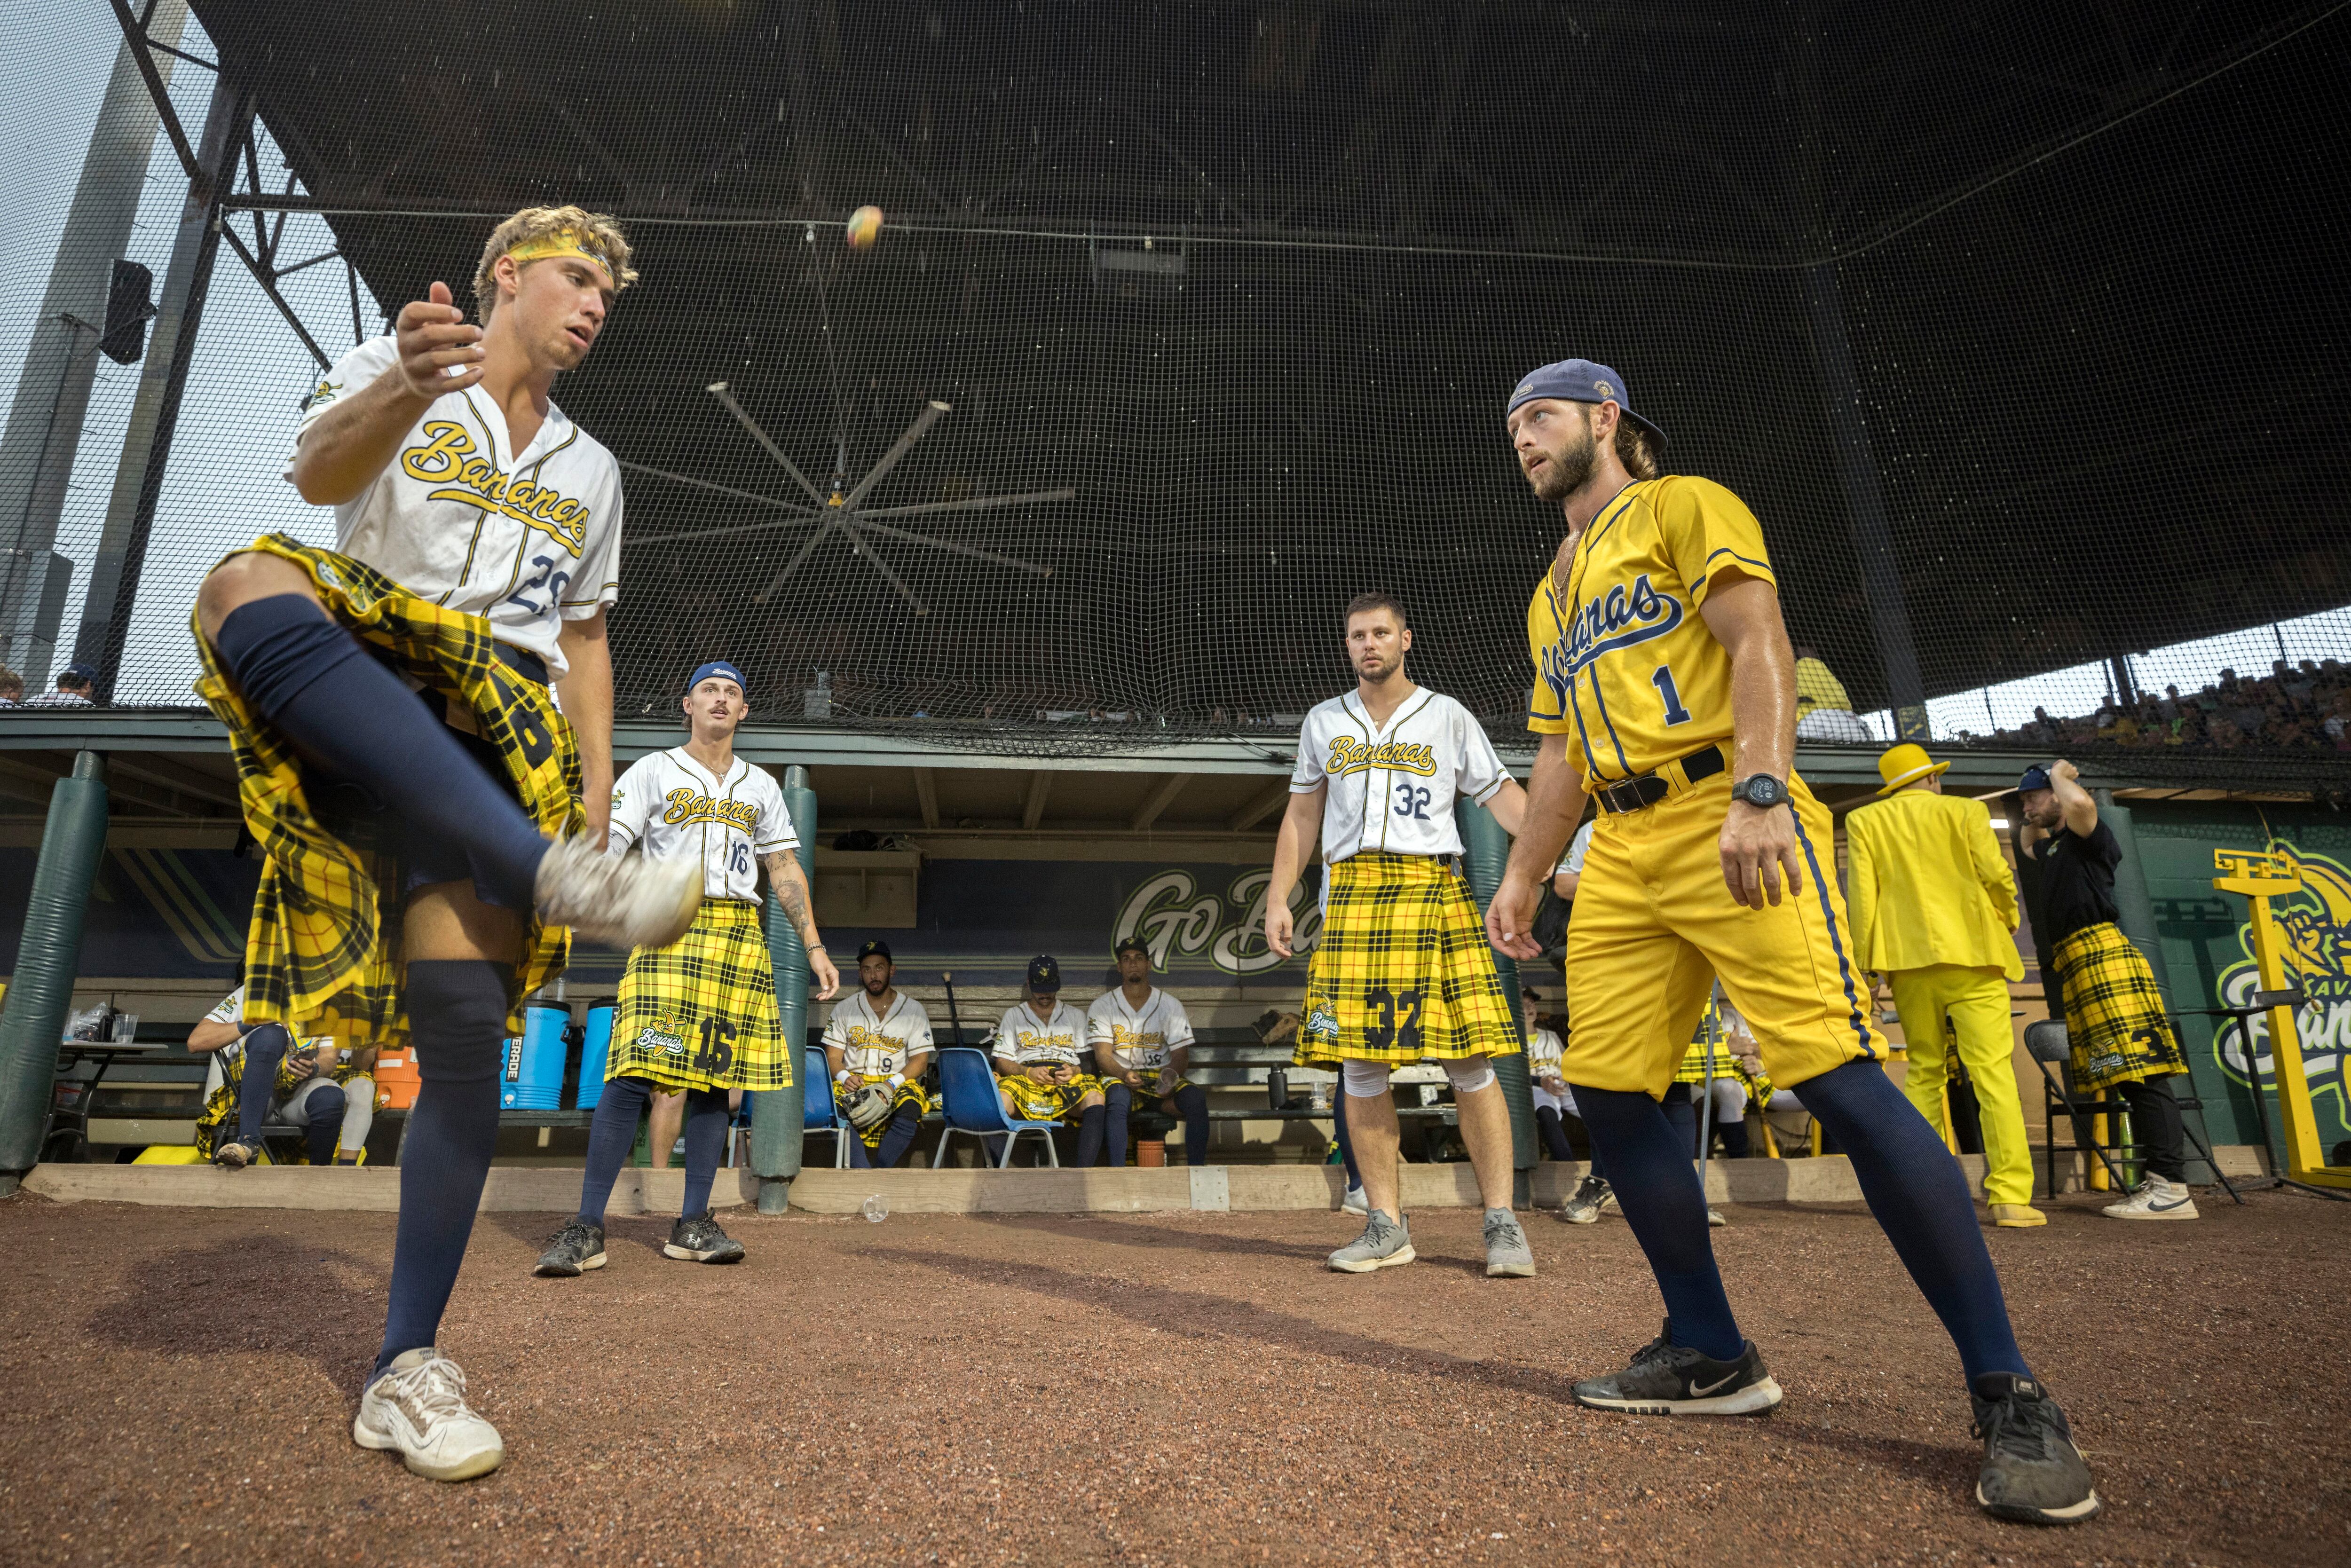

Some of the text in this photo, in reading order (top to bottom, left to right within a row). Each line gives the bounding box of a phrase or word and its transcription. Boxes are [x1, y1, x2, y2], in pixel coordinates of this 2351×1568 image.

[401, 421, 590, 559] Bananas
[712, 668, 736, 679] Bananas
[1651, 664, 1692, 727] 1
[1326, 736, 1436, 780] Bananas
[663, 788, 759, 836] Bananas
[1394, 784, 1431, 820] 32
[729, 841, 749, 875] 16
[1111, 869, 1223, 974] Go
[2303, 978, 2351, 998] SAV
[1112, 1024, 1165, 1050] Bananas
[1364, 991, 1421, 1049] 32
[637, 1028, 685, 1054] Bananas
[693, 1016, 737, 1074] 16
[881, 1057, 892, 1072] 9
